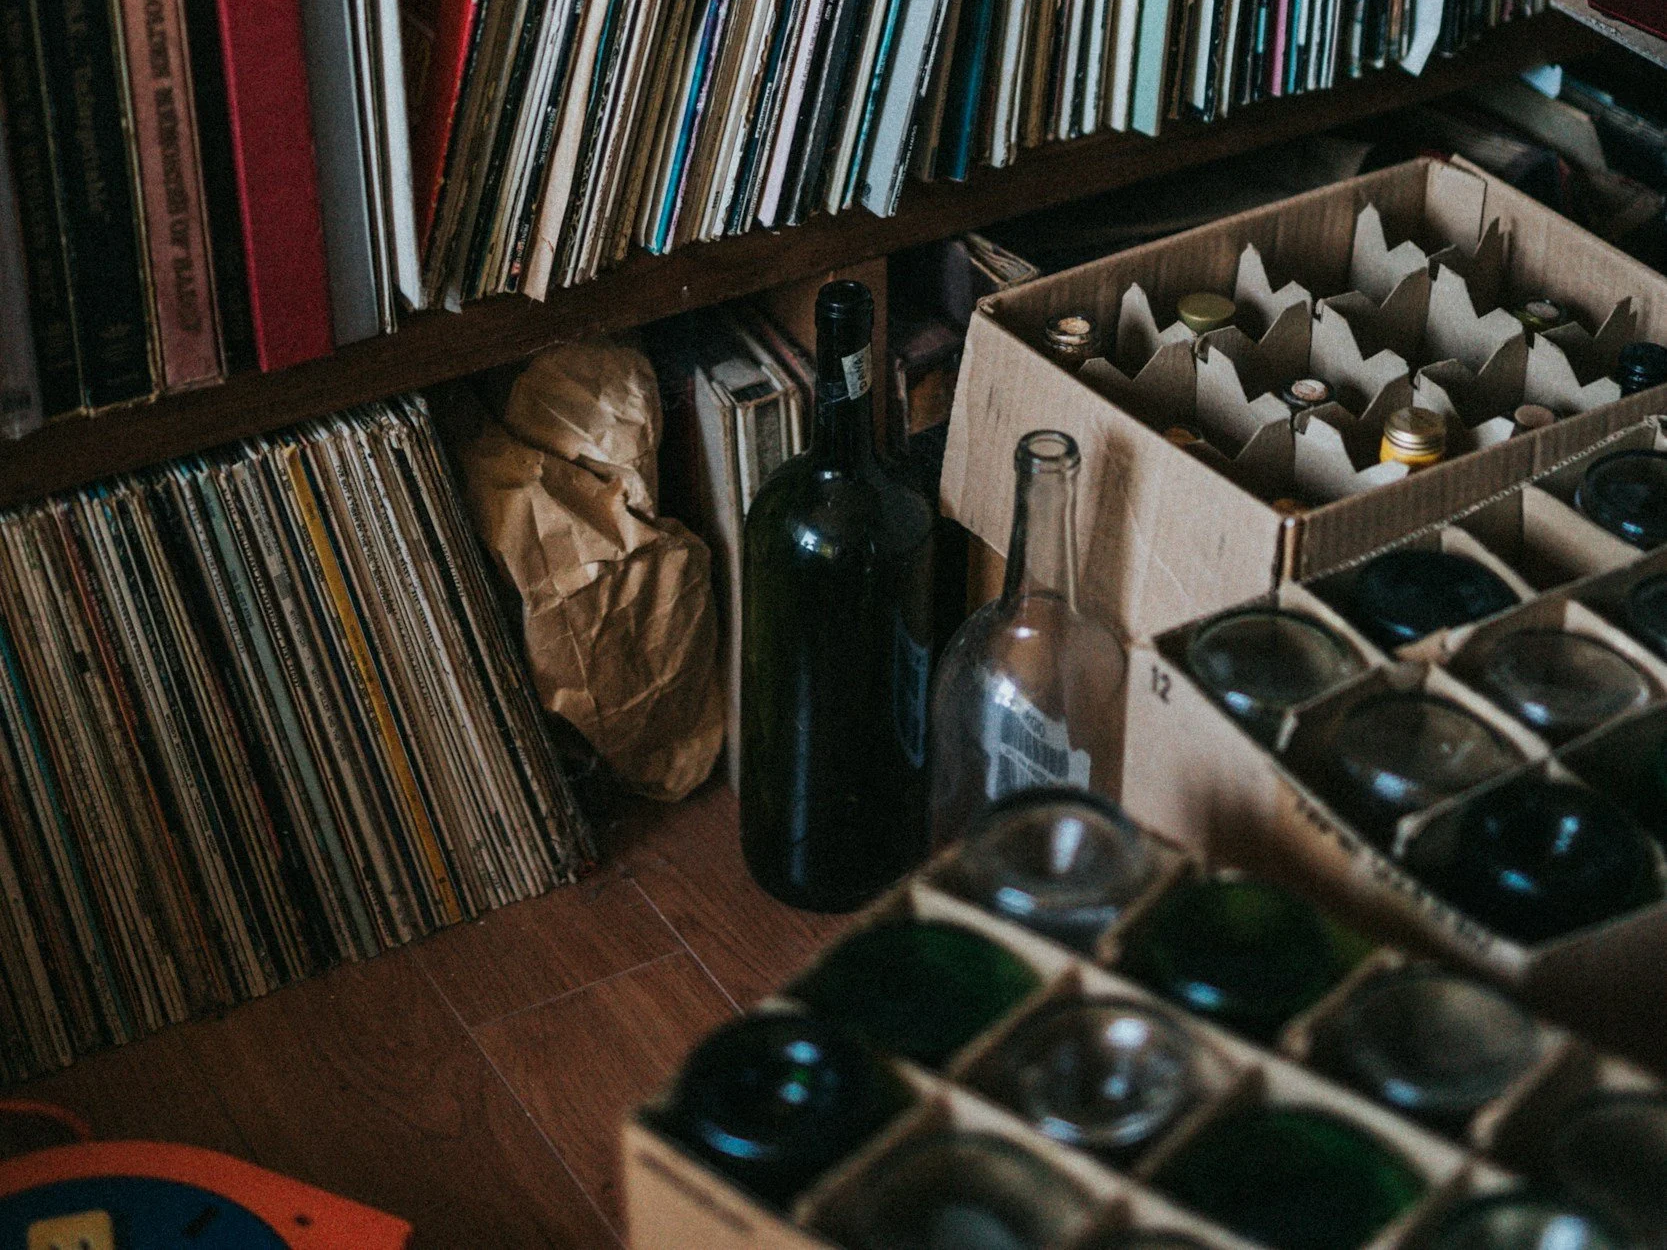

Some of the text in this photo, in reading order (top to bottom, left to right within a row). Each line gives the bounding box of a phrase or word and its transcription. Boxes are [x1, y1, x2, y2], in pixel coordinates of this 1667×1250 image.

[815, 0, 825, 20] EMPIRE
[811, 20, 820, 36] INCA
[808, 36, 816, 47] THE
[801, 57, 811, 78] FLUTES
[798, 79, 806, 90] THE
[546, 107, 557, 128] RSO
[153, 86, 187, 215] MEMORIES
[540, 127, 552, 154] RECORDS
[167, 217, 191, 255] OF
[519, 222, 530, 246] PRINTED
[254, 517, 274, 557] SING-ALONG
[334, 463, 393, 616] I'VE GOT A TIGER BY THE TAIL BUCK OWENS
[233, 583, 241, 591] IS
[236, 591, 247, 608] CHET
[241, 606, 255, 628] ATKINS
[294, 627, 308, 649] MITCH
[1151, 665, 1172, 705] 12
[309, 668, 322, 690] MITCH
[317, 690, 330, 712] MILLER
[326, 714, 336, 728] AND
[331, 729, 341, 742] THE
[163, 713, 178, 740] WOODY
